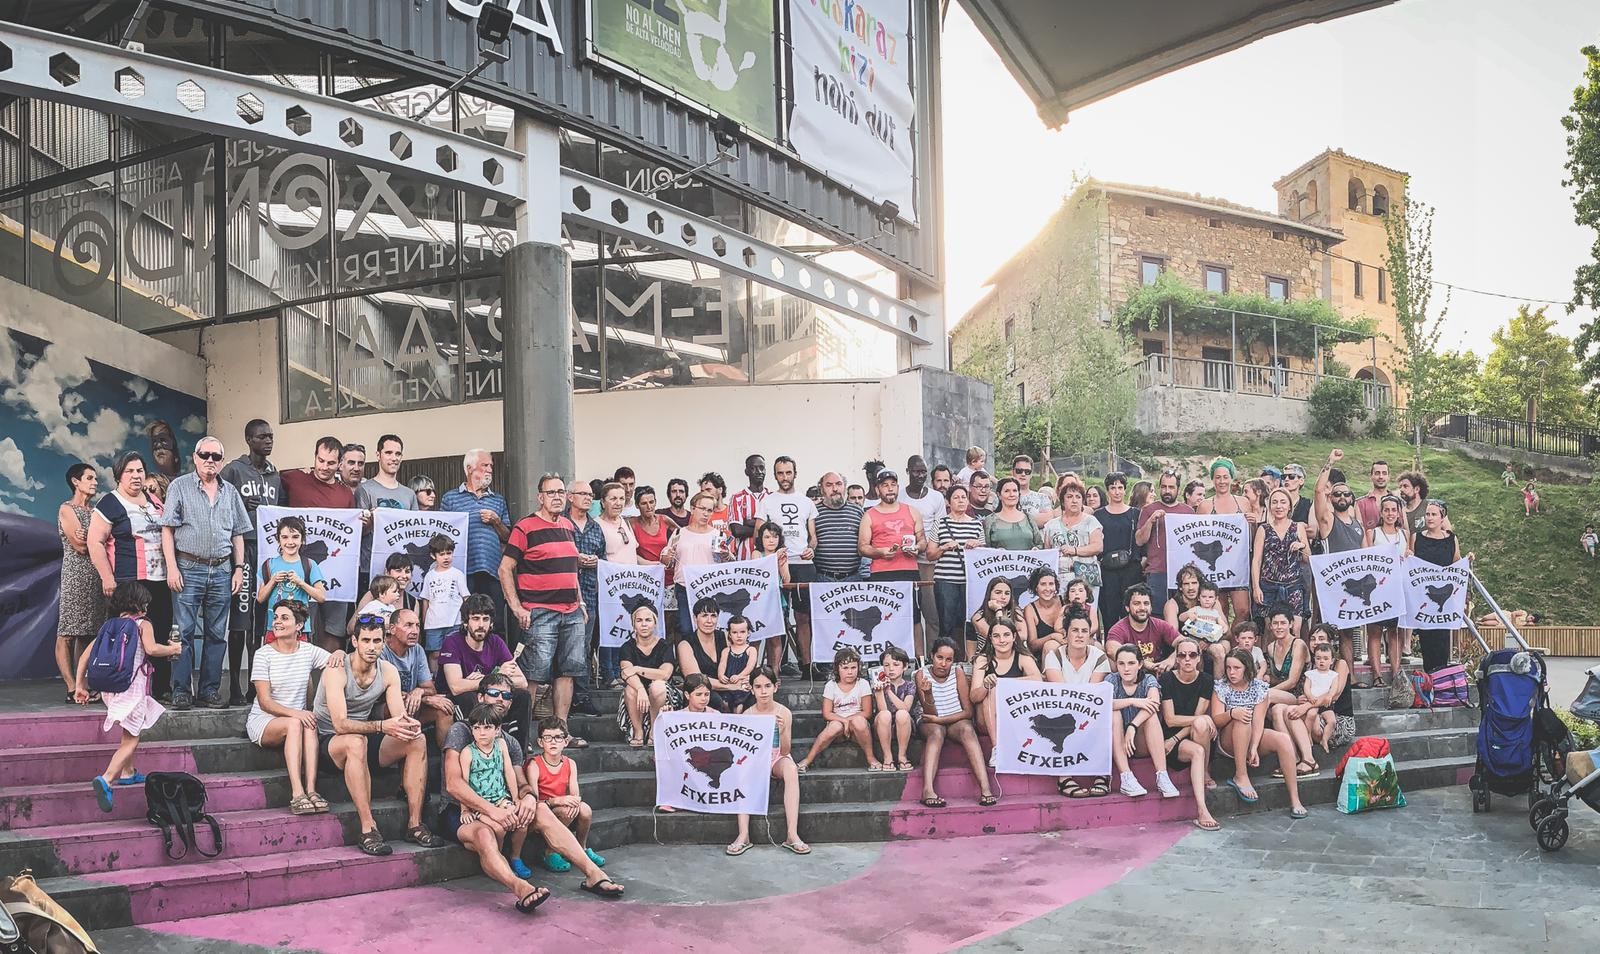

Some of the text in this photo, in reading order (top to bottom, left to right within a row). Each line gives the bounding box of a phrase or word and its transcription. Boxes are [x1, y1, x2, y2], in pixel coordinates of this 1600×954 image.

[625, 4, 639, 26] NO
[643, 13, 653, 33] AL
[656, 20, 681, 47] TREN
[626, 21, 681, 58] DE ALTA VELOCIDAD
[865, 104, 896, 151] dut
[263, 515, 353, 534] EUAL PRESO
[384, 518, 460, 537] EUSKAL PRESO
[1173, 520, 1242, 536] EUSKAL PRESO
[266, 527, 350, 547] ET SLARIAK
[387, 533, 403, 547] ETA
[1177, 530, 1240, 545] ETA IHESLARIAK
[973, 554, 1014, 568] EUSKAL
[1320, 554, 1394, 577] EUSKAL PRESO
[605, 570, 661, 588] EUSKAL PRESO
[690, 567, 771, 590] EUSKAL PRESO
[977, 564, 1034, 579] ETA IHESLAR
[1203, 569, 1236, 583] XERA
[1325, 564, 1393, 587] ETA IHESLARIAK
[619, 582, 660, 598] IHESLARIAK
[695, 578, 769, 600] ETA IHESLARIAK
[1411, 577, 1425, 587] ETA
[819, 583, 905, 603] EUSKAL PRESO
[824, 594, 902, 614] ETA IHESLARIAK
[1338, 601, 1393, 620] ETXERA
[1415, 611, 1461, 623] ETXERA
[609, 625, 636, 640] ETX
[1005, 688, 1104, 706] EUSKAL PRESO
[1010, 700, 1101, 720] ETA IHESLARIAK
[664, 721, 763, 742] EUSKAL PRESO
[689, 733, 759, 755] IHESLARIAK
[1017, 750, 1089, 768] ETXERA
[680, 784, 746, 805] ETXERA
